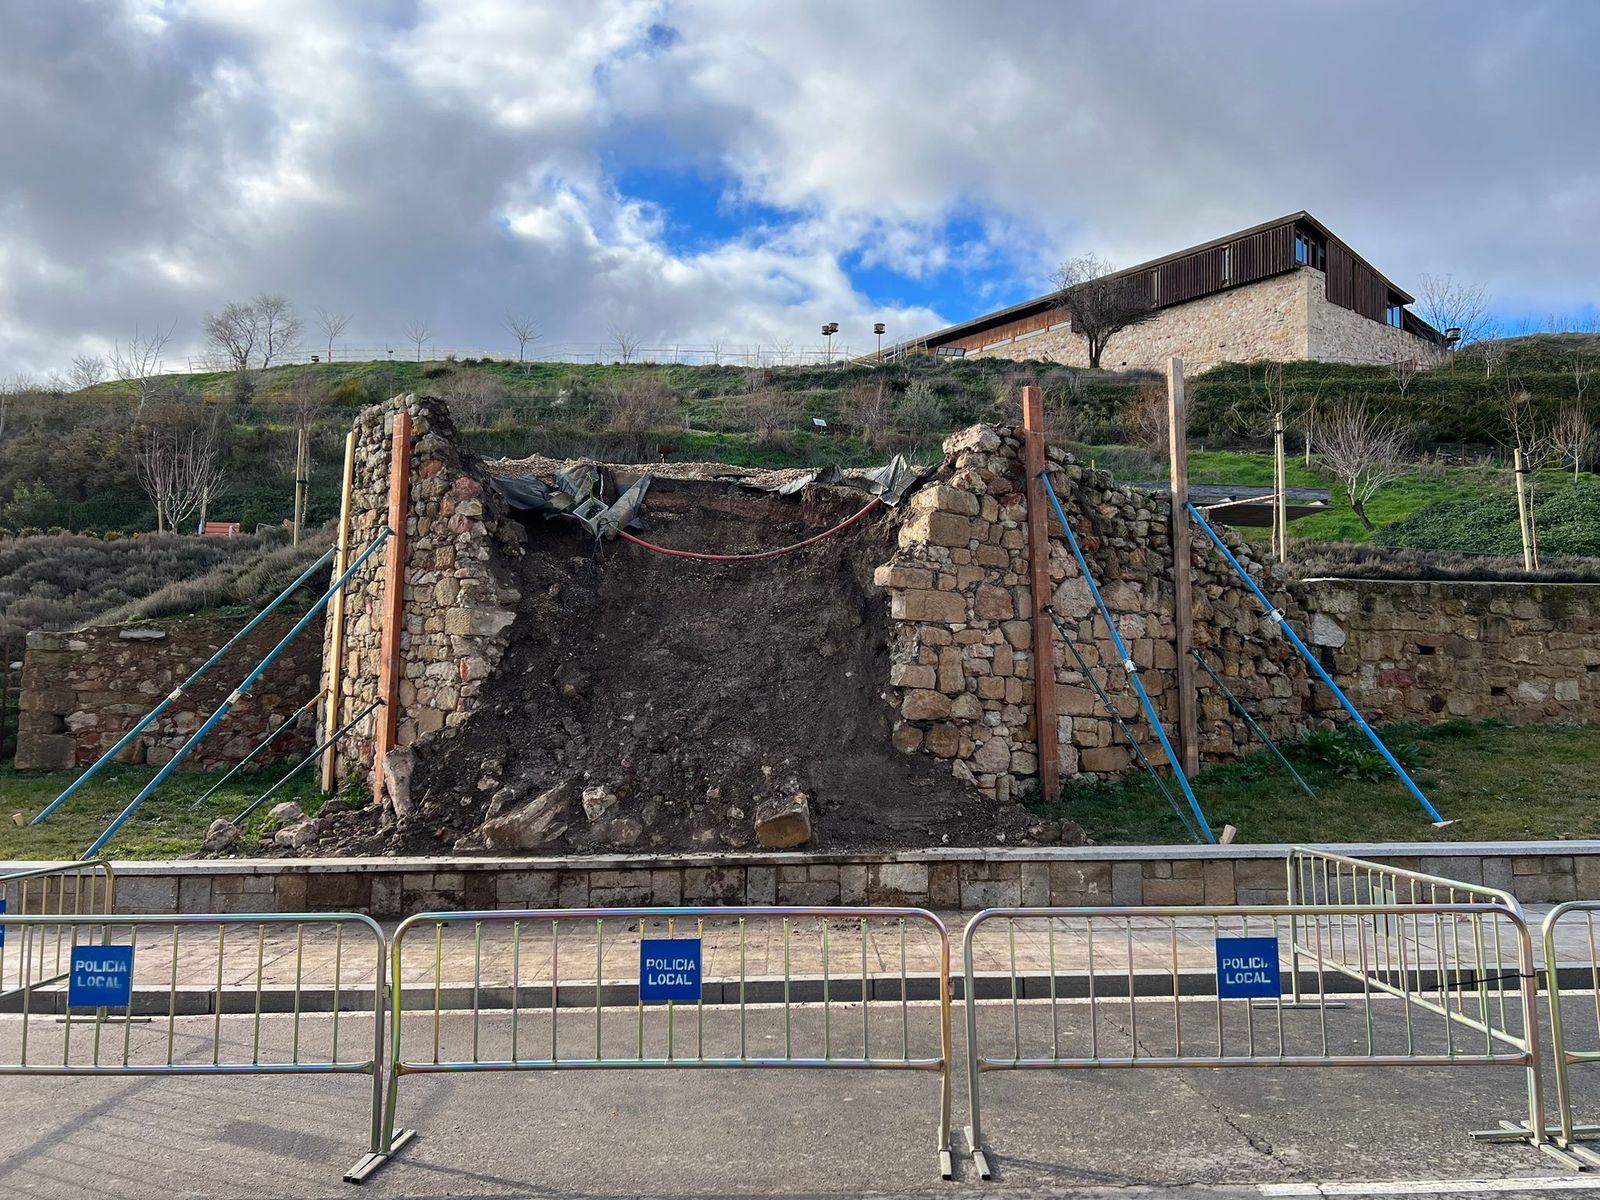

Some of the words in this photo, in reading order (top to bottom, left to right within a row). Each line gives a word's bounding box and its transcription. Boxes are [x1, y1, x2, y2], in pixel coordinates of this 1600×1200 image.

[75, 960, 127, 972] POLICIA
[646, 959, 695, 970] POLICIA
[77, 976, 122, 988] LOCAL
[648, 973, 692, 985] LOCAL
[1226, 972, 1271, 984] LOCAL
